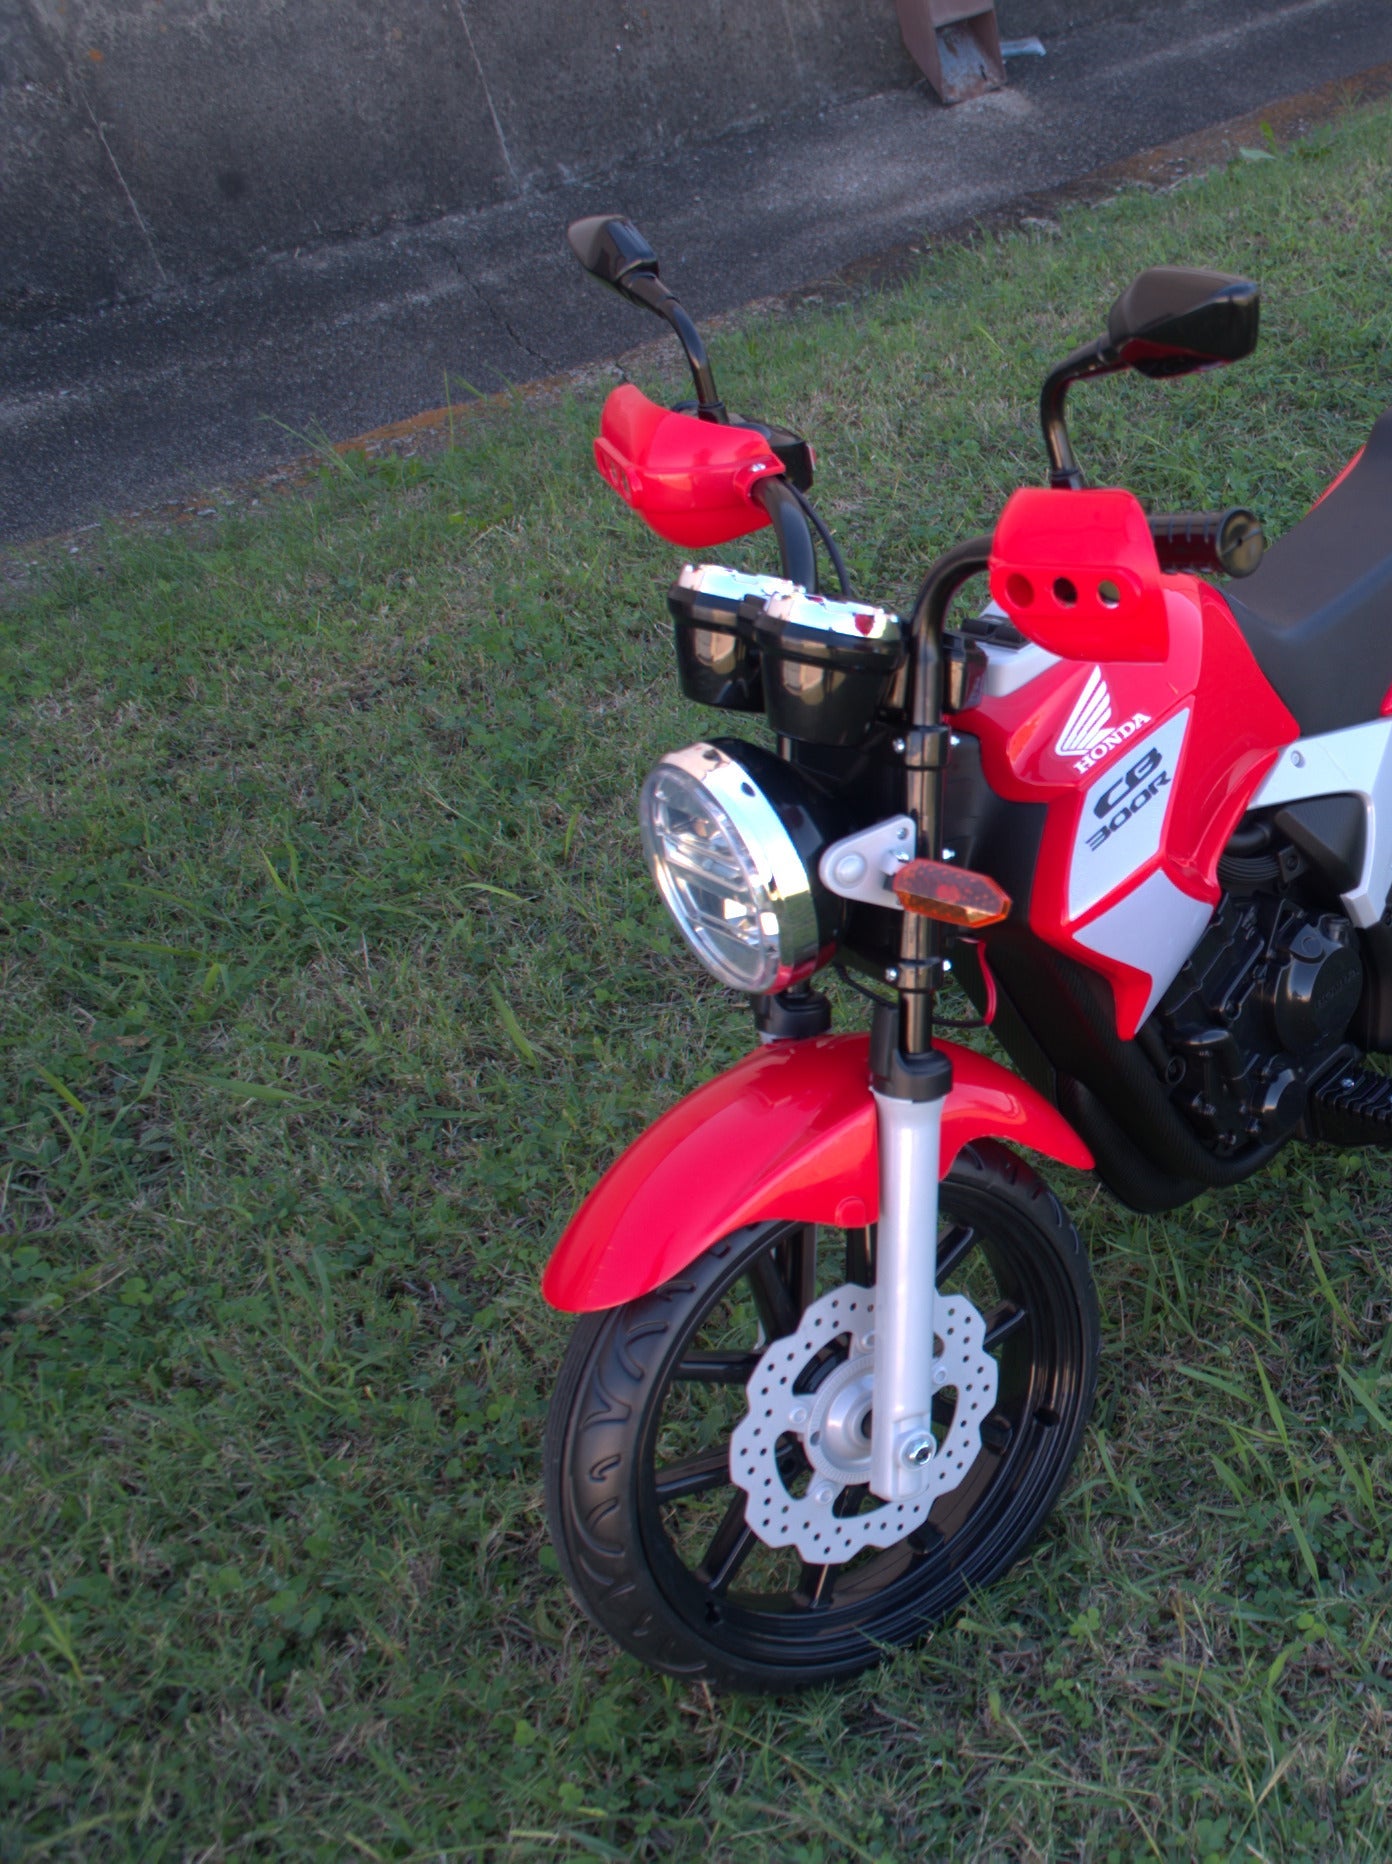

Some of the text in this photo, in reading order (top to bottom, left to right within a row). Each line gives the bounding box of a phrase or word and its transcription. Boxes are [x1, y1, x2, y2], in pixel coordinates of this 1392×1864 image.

[1073, 711, 1152, 775] HONDA
[1084, 770, 1171, 852] 300R
[1092, 747, 1163, 820] CB
